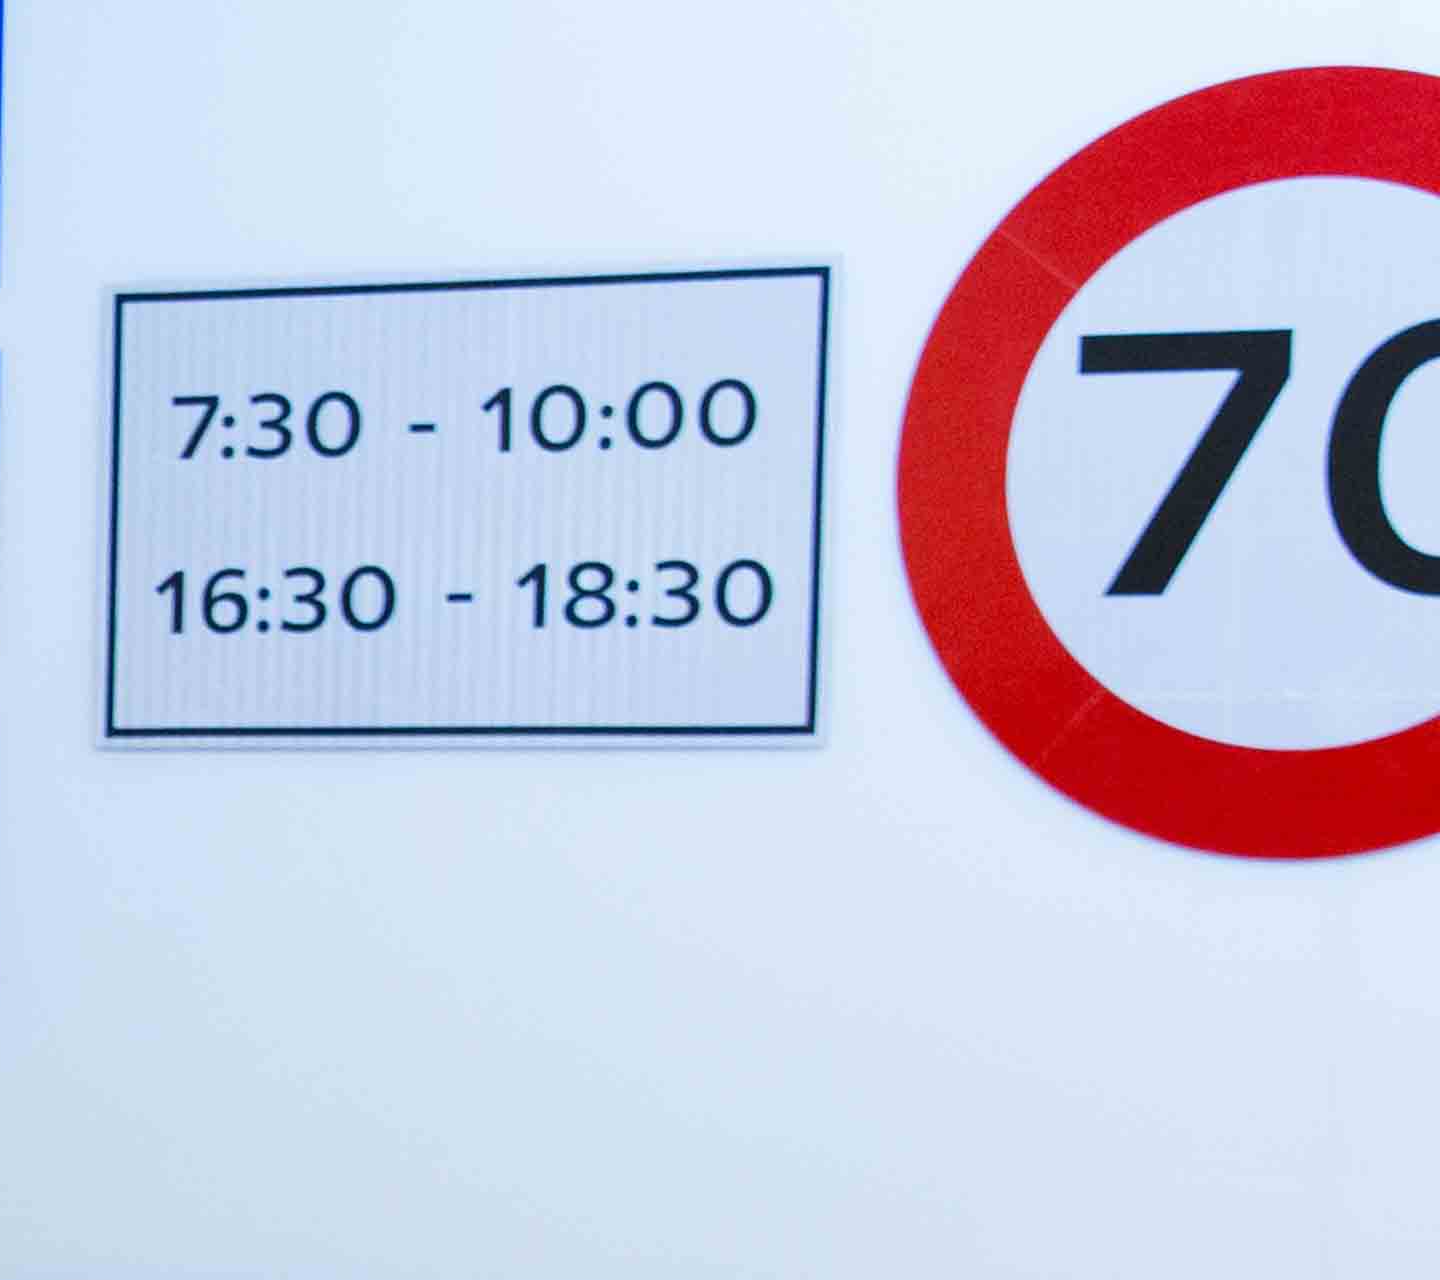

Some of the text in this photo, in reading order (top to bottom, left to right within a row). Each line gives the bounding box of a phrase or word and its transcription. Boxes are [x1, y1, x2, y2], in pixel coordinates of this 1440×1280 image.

[171, 377, 758, 460] 7:30 - 10:00
[154, 558, 774, 635] 16:30 - 18:30
